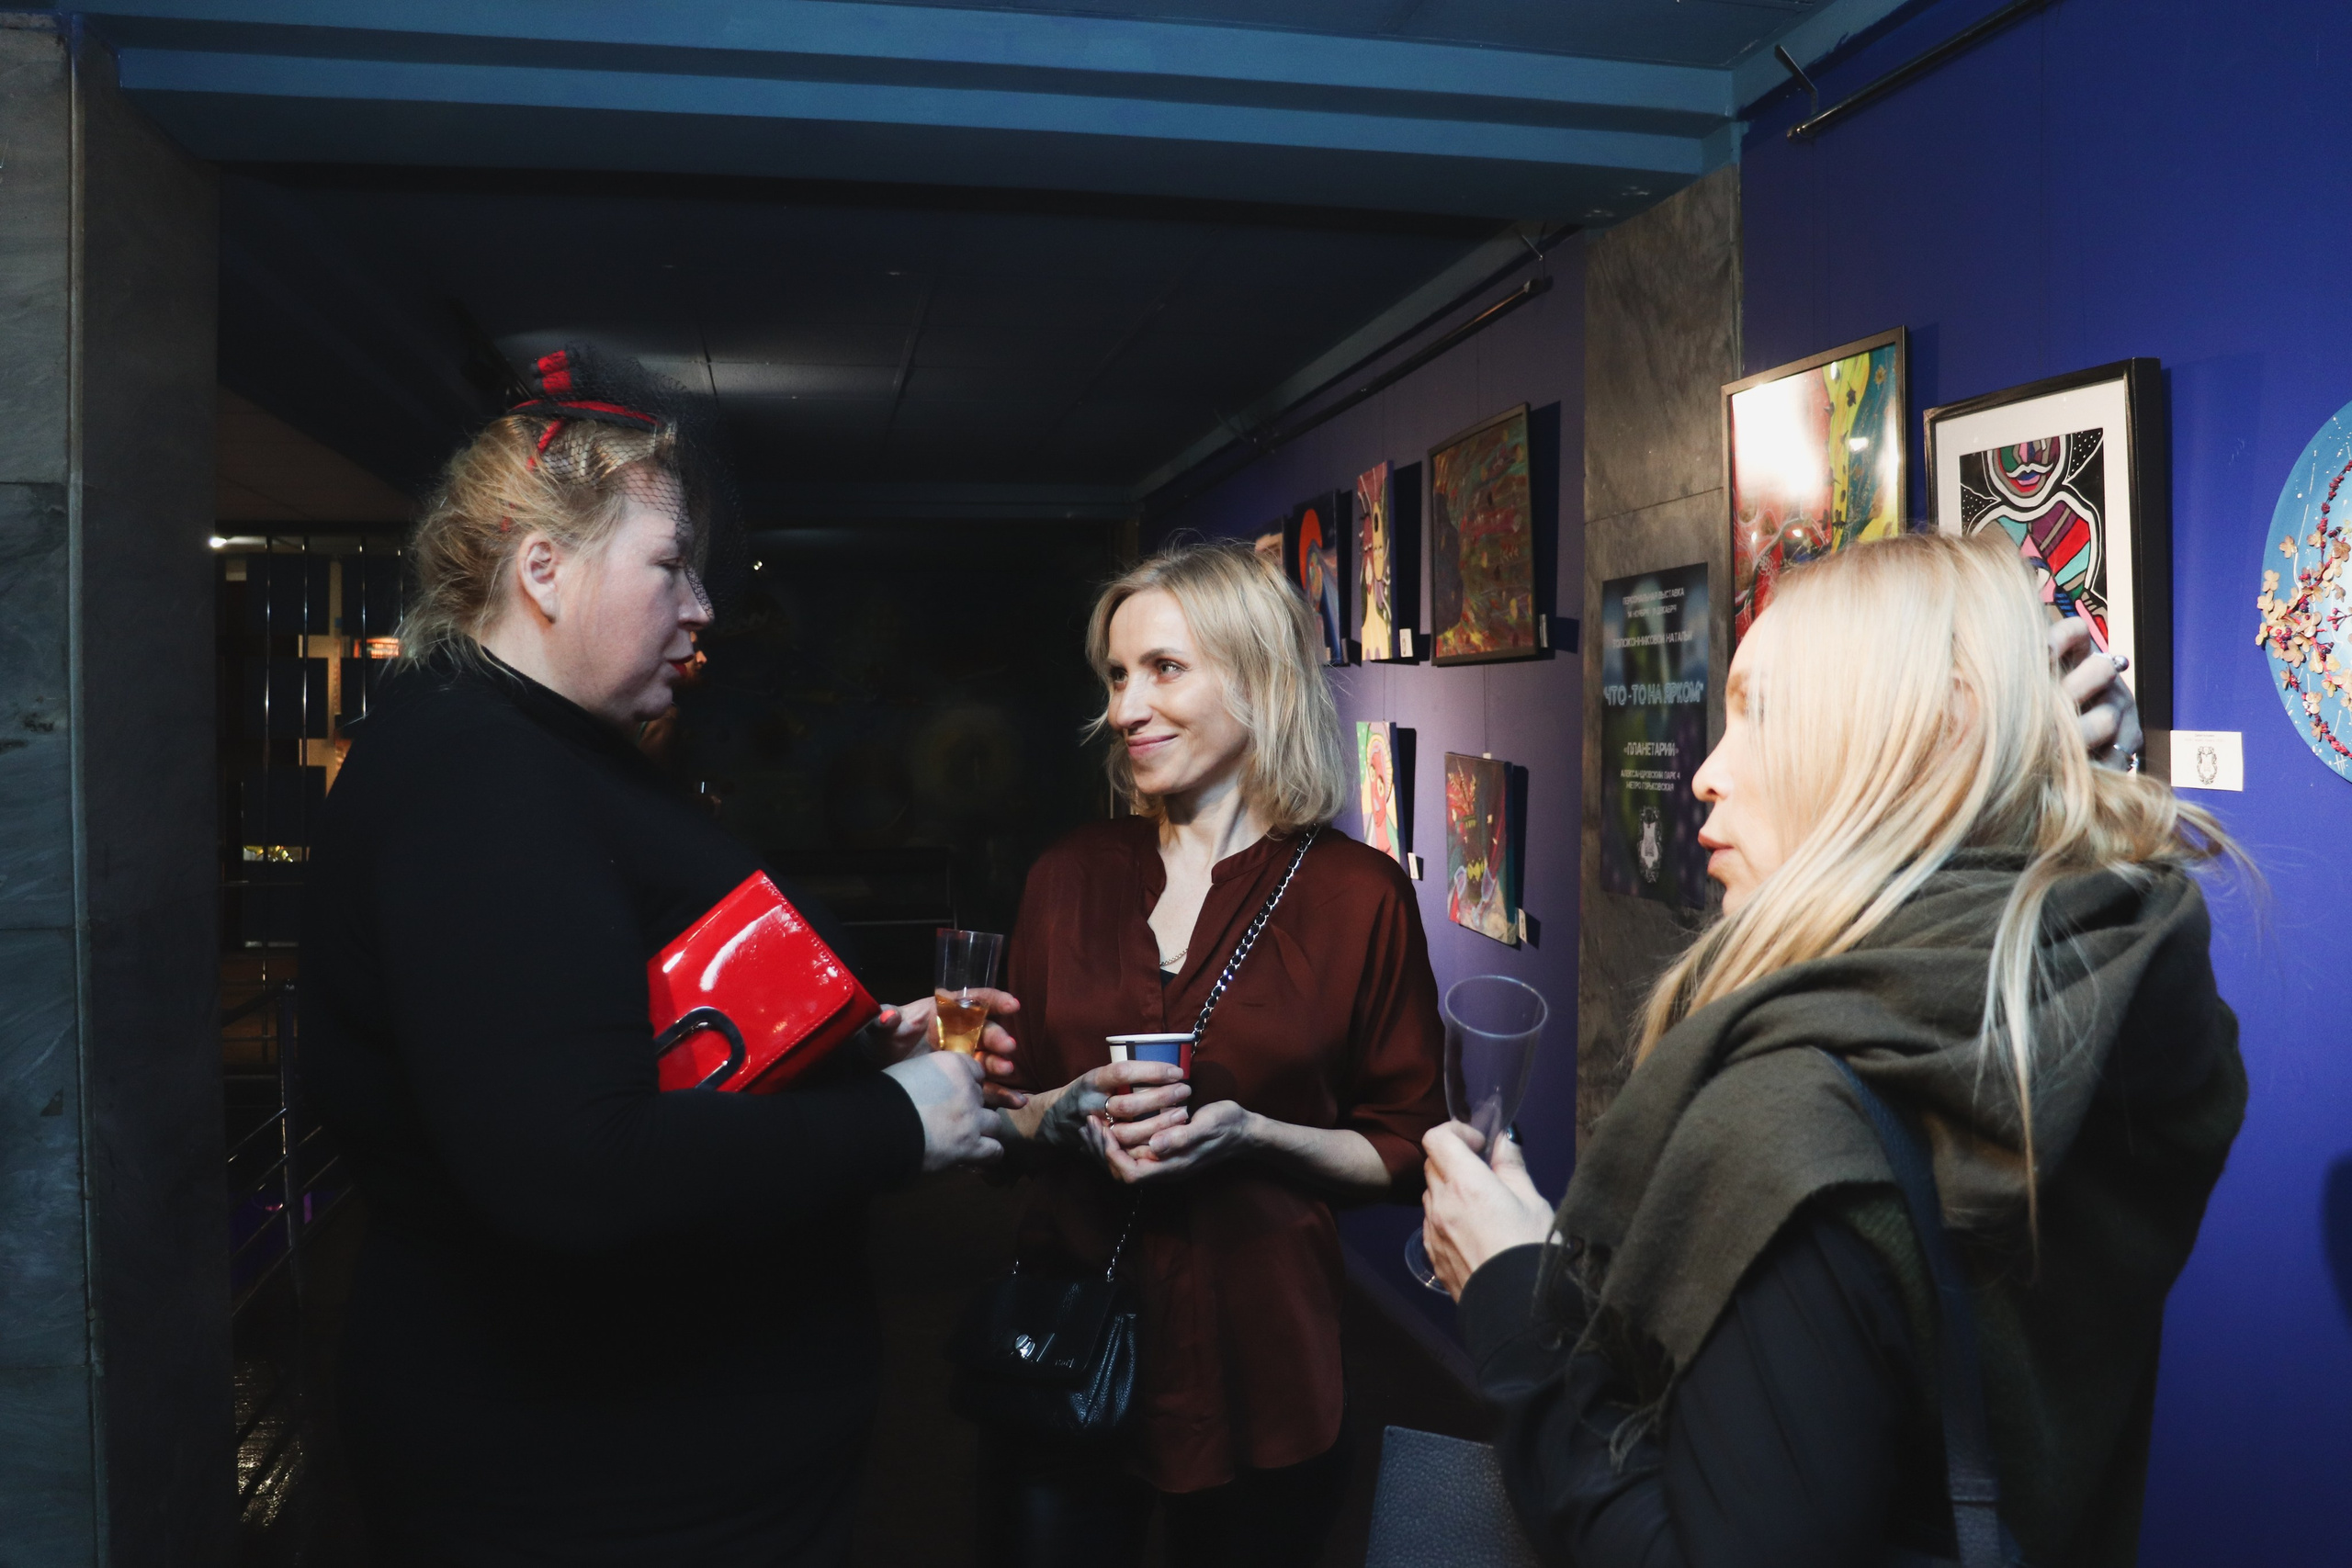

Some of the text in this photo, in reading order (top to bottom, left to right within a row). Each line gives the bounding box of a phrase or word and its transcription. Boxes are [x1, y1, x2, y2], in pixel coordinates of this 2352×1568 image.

[1658, 587, 1685, 600] ВЫСТАВКА
[1666, 630, 1692, 643] НАТАЛЬИ
[1647, 683, 1662, 705] НА
[1664, 771, 1677, 780] ПАРК
[1625, 781, 1675, 792] МЕТРО ГОРЬКОВСКАЯ
